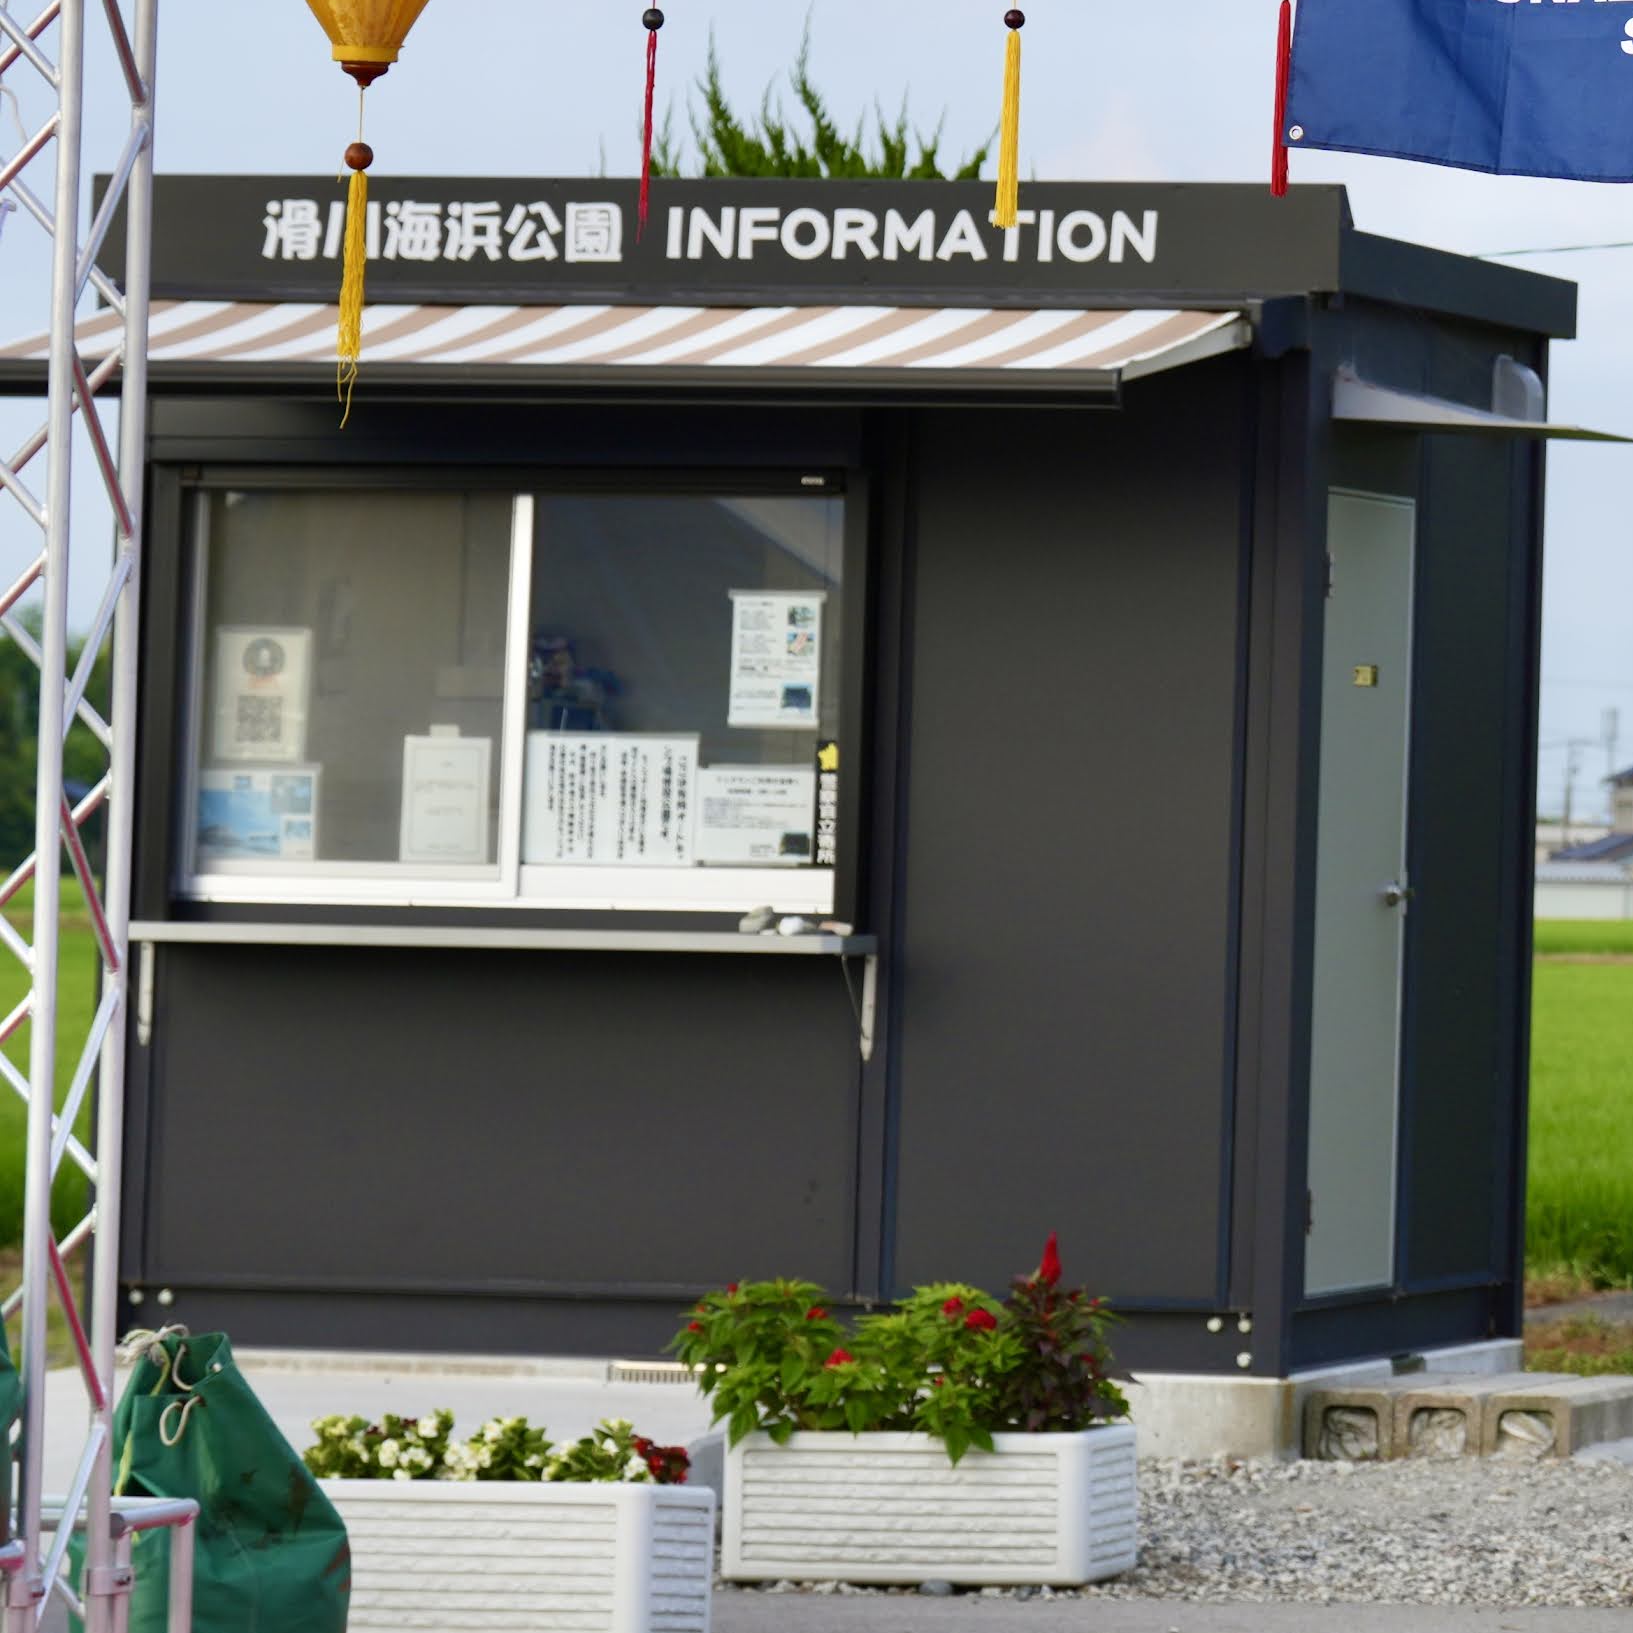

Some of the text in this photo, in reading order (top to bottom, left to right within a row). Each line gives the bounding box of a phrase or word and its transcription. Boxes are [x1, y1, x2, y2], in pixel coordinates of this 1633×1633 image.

[261, 198, 623, 263] 滑川海浜公園
[666, 206, 1158, 263] INFORMATION
